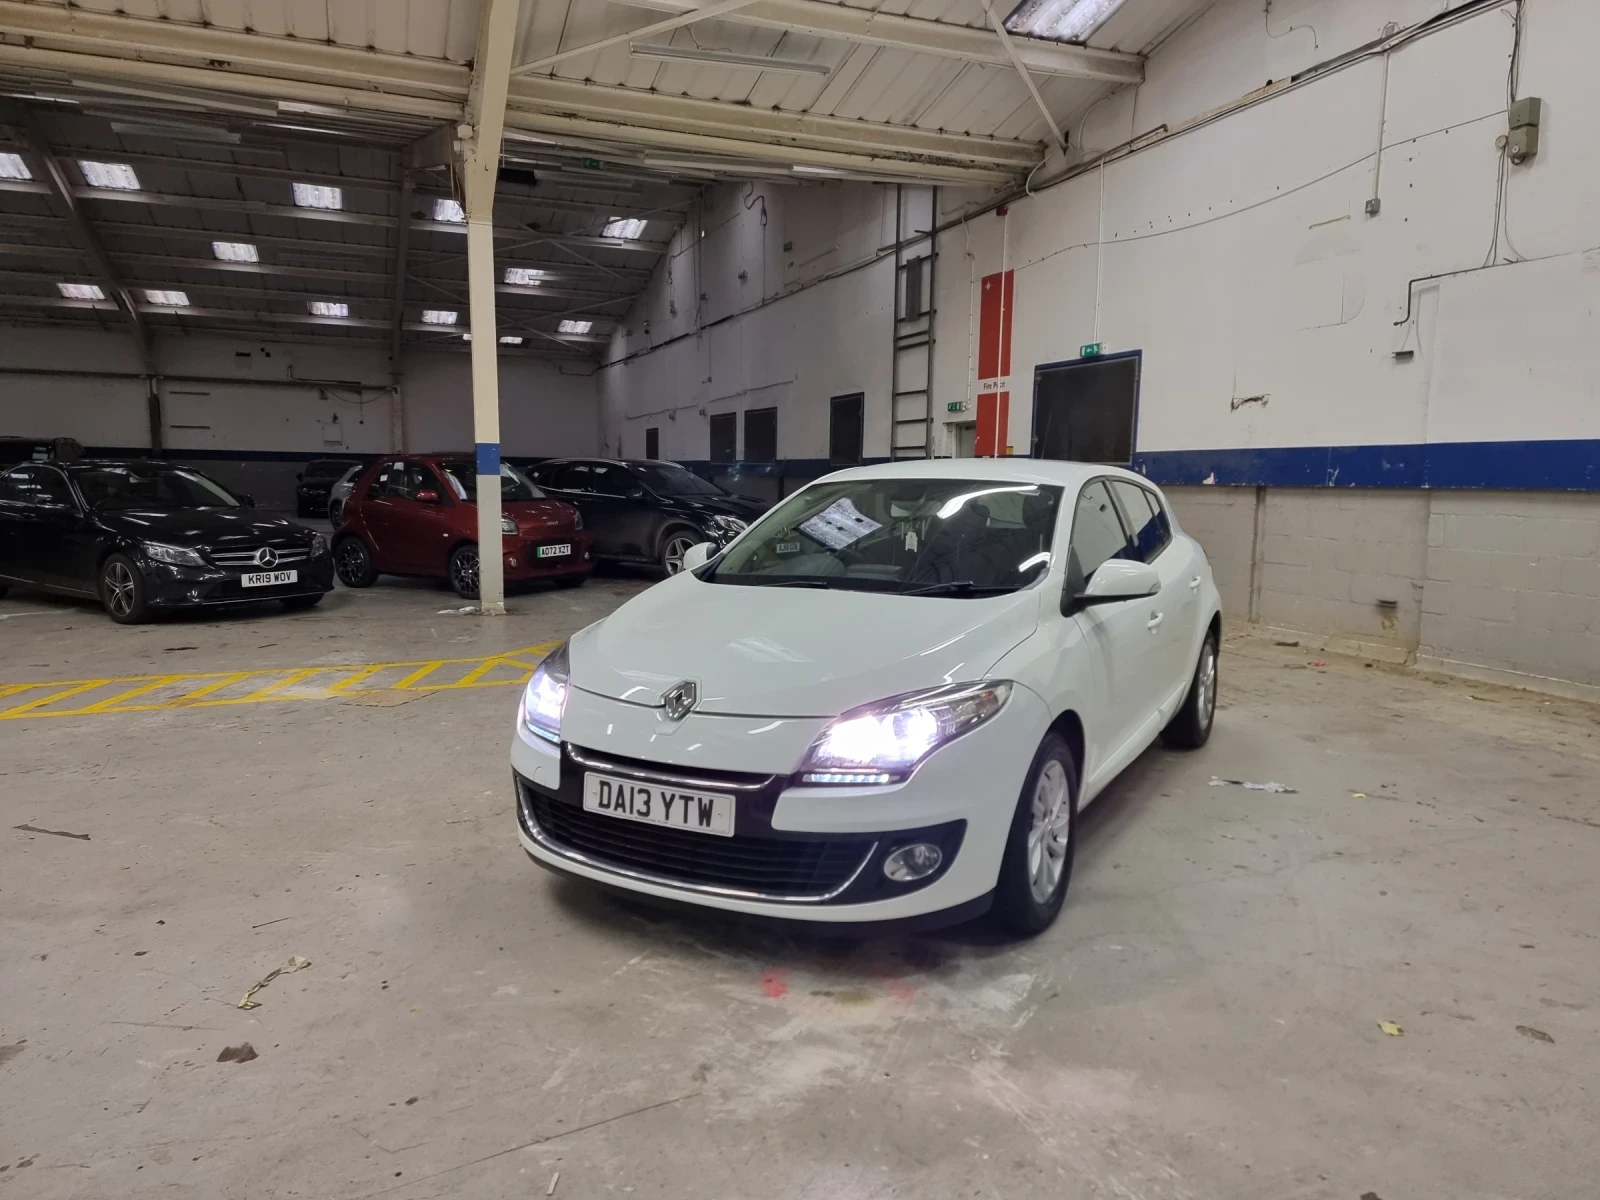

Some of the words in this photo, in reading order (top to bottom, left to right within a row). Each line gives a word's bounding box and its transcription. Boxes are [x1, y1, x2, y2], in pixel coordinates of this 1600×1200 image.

[983, 382, 992, 390] Fire
[248, 573, 271, 585] KR19
[274, 571, 291, 582] WOV
[598, 780, 651, 817] DA13
[660, 791, 714, 827] YTW
